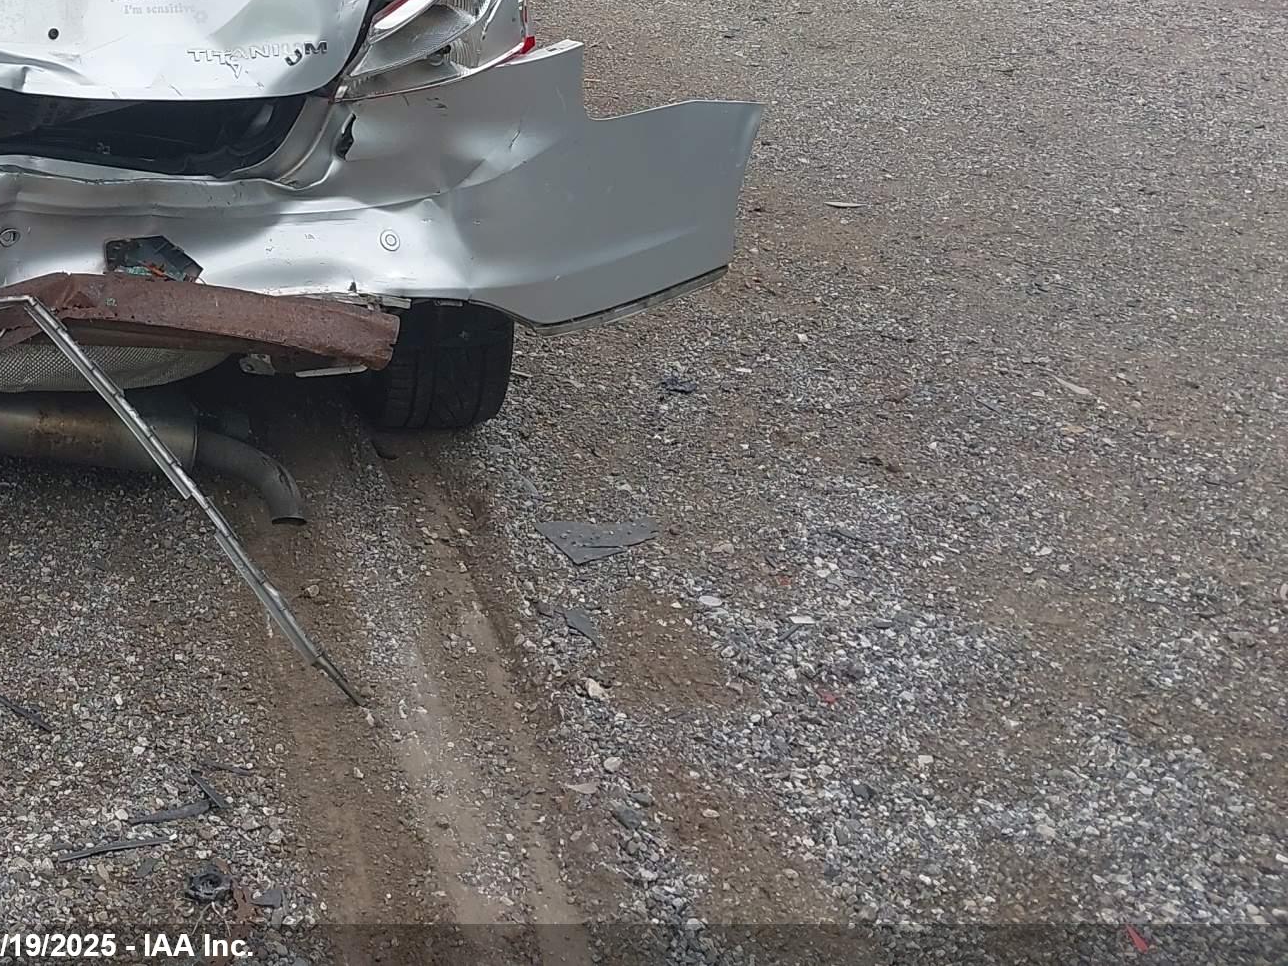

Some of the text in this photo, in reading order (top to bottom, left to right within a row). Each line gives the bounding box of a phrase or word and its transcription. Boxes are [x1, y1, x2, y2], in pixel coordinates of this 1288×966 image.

[124, 2, 196, 15] I'm sensitive
[187, 40, 328, 67] TITANIUM
